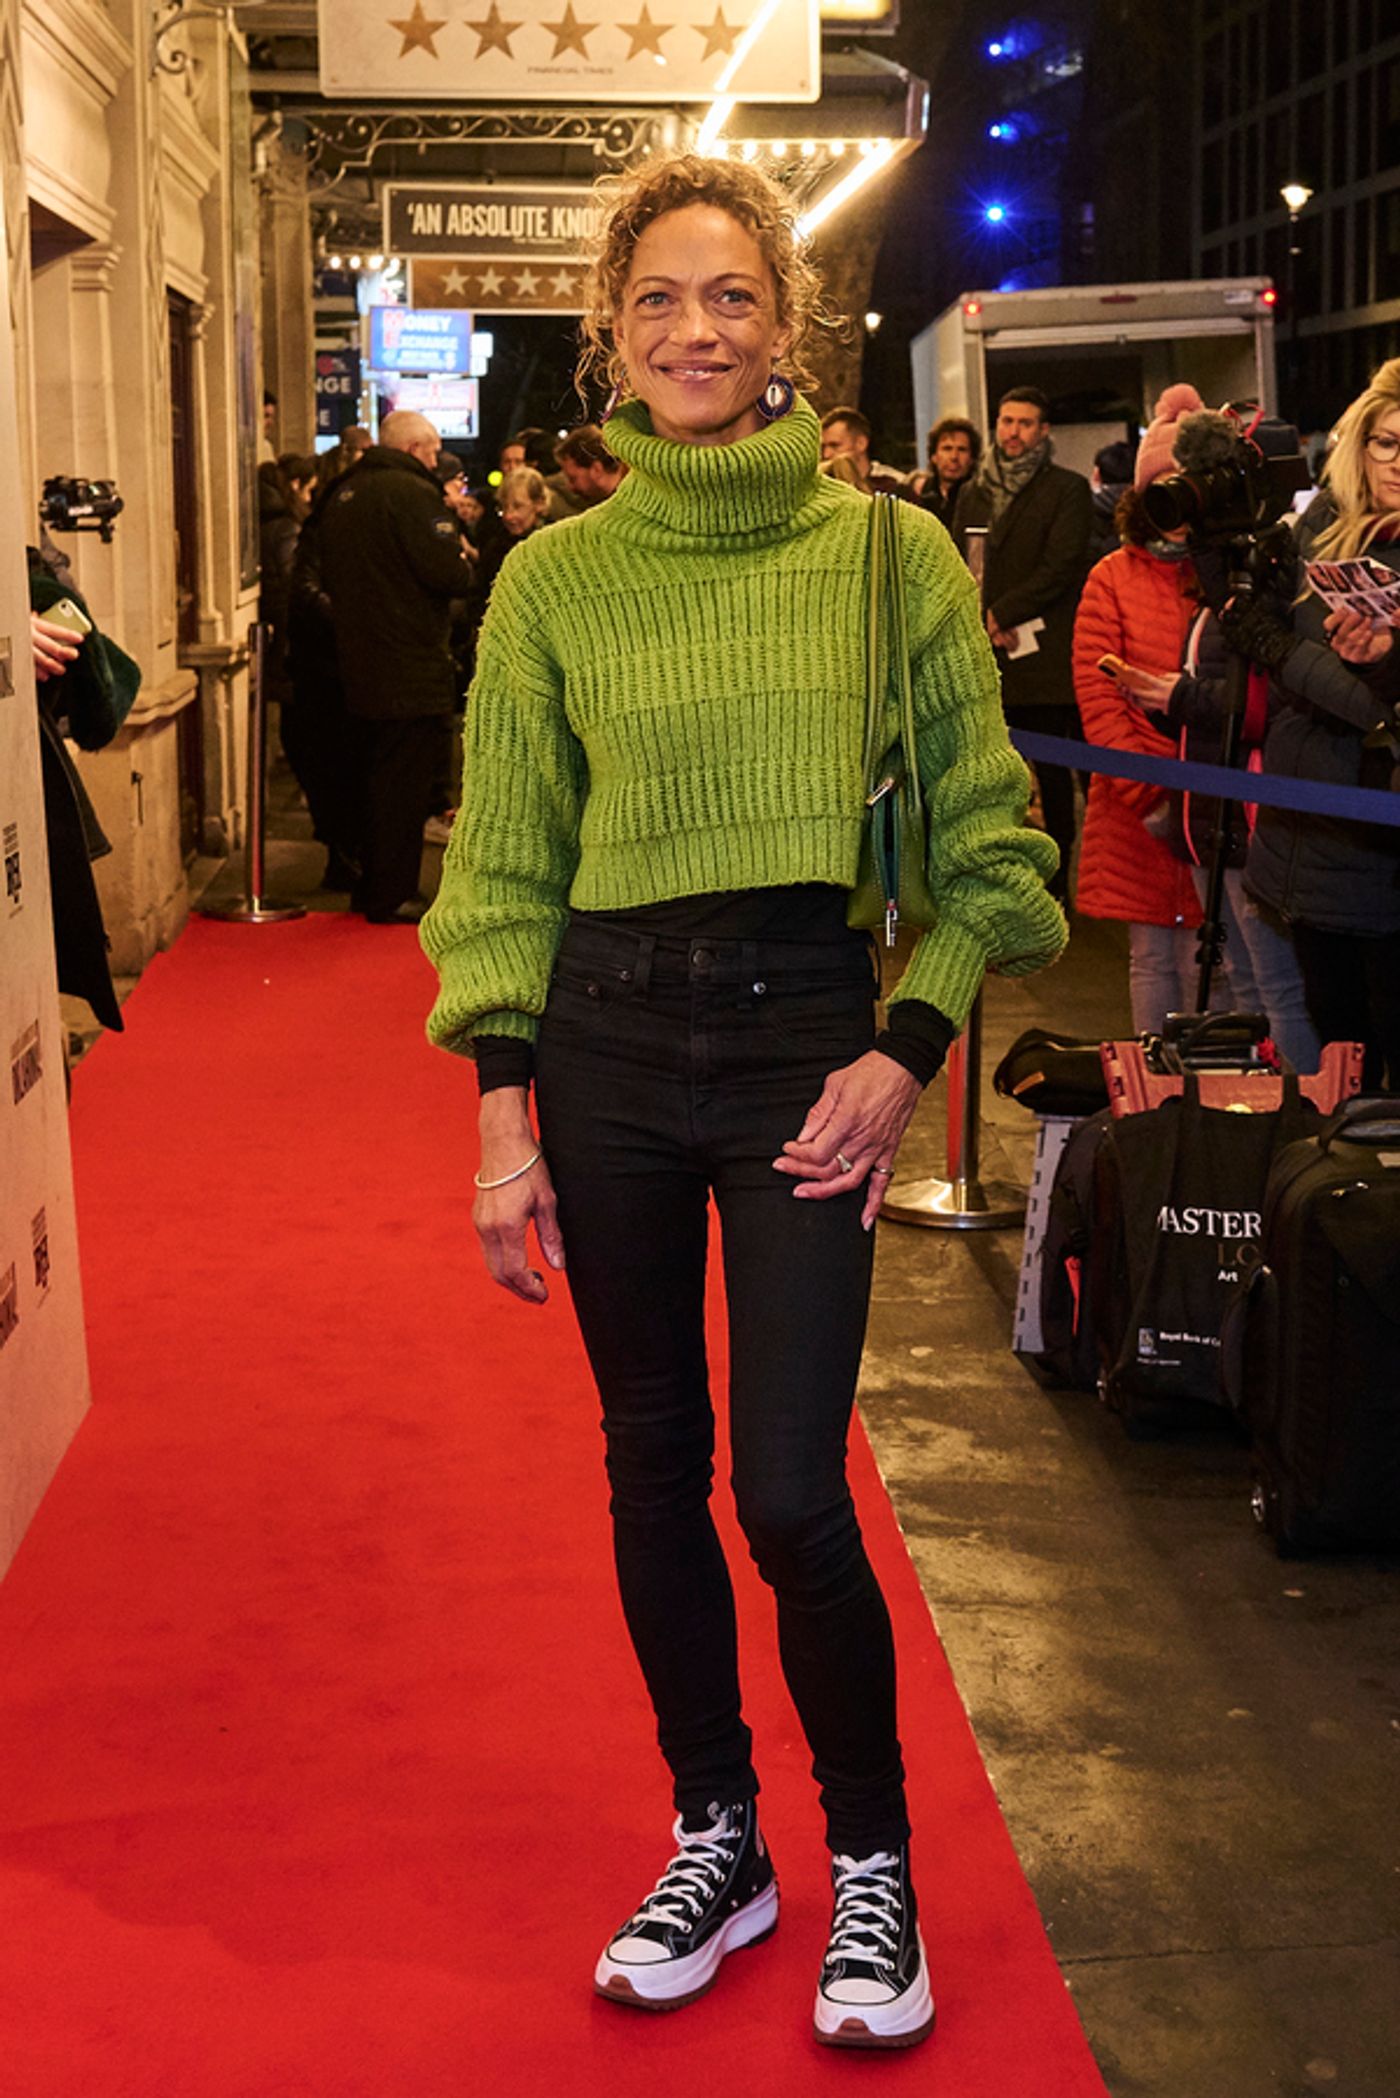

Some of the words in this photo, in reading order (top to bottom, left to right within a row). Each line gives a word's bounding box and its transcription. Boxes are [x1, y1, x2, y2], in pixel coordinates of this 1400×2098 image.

[446, 204, 547, 237] ABSOLUTE
[383, 309, 452, 333] MONEY
[383, 331, 458, 351] EXCHANGE
